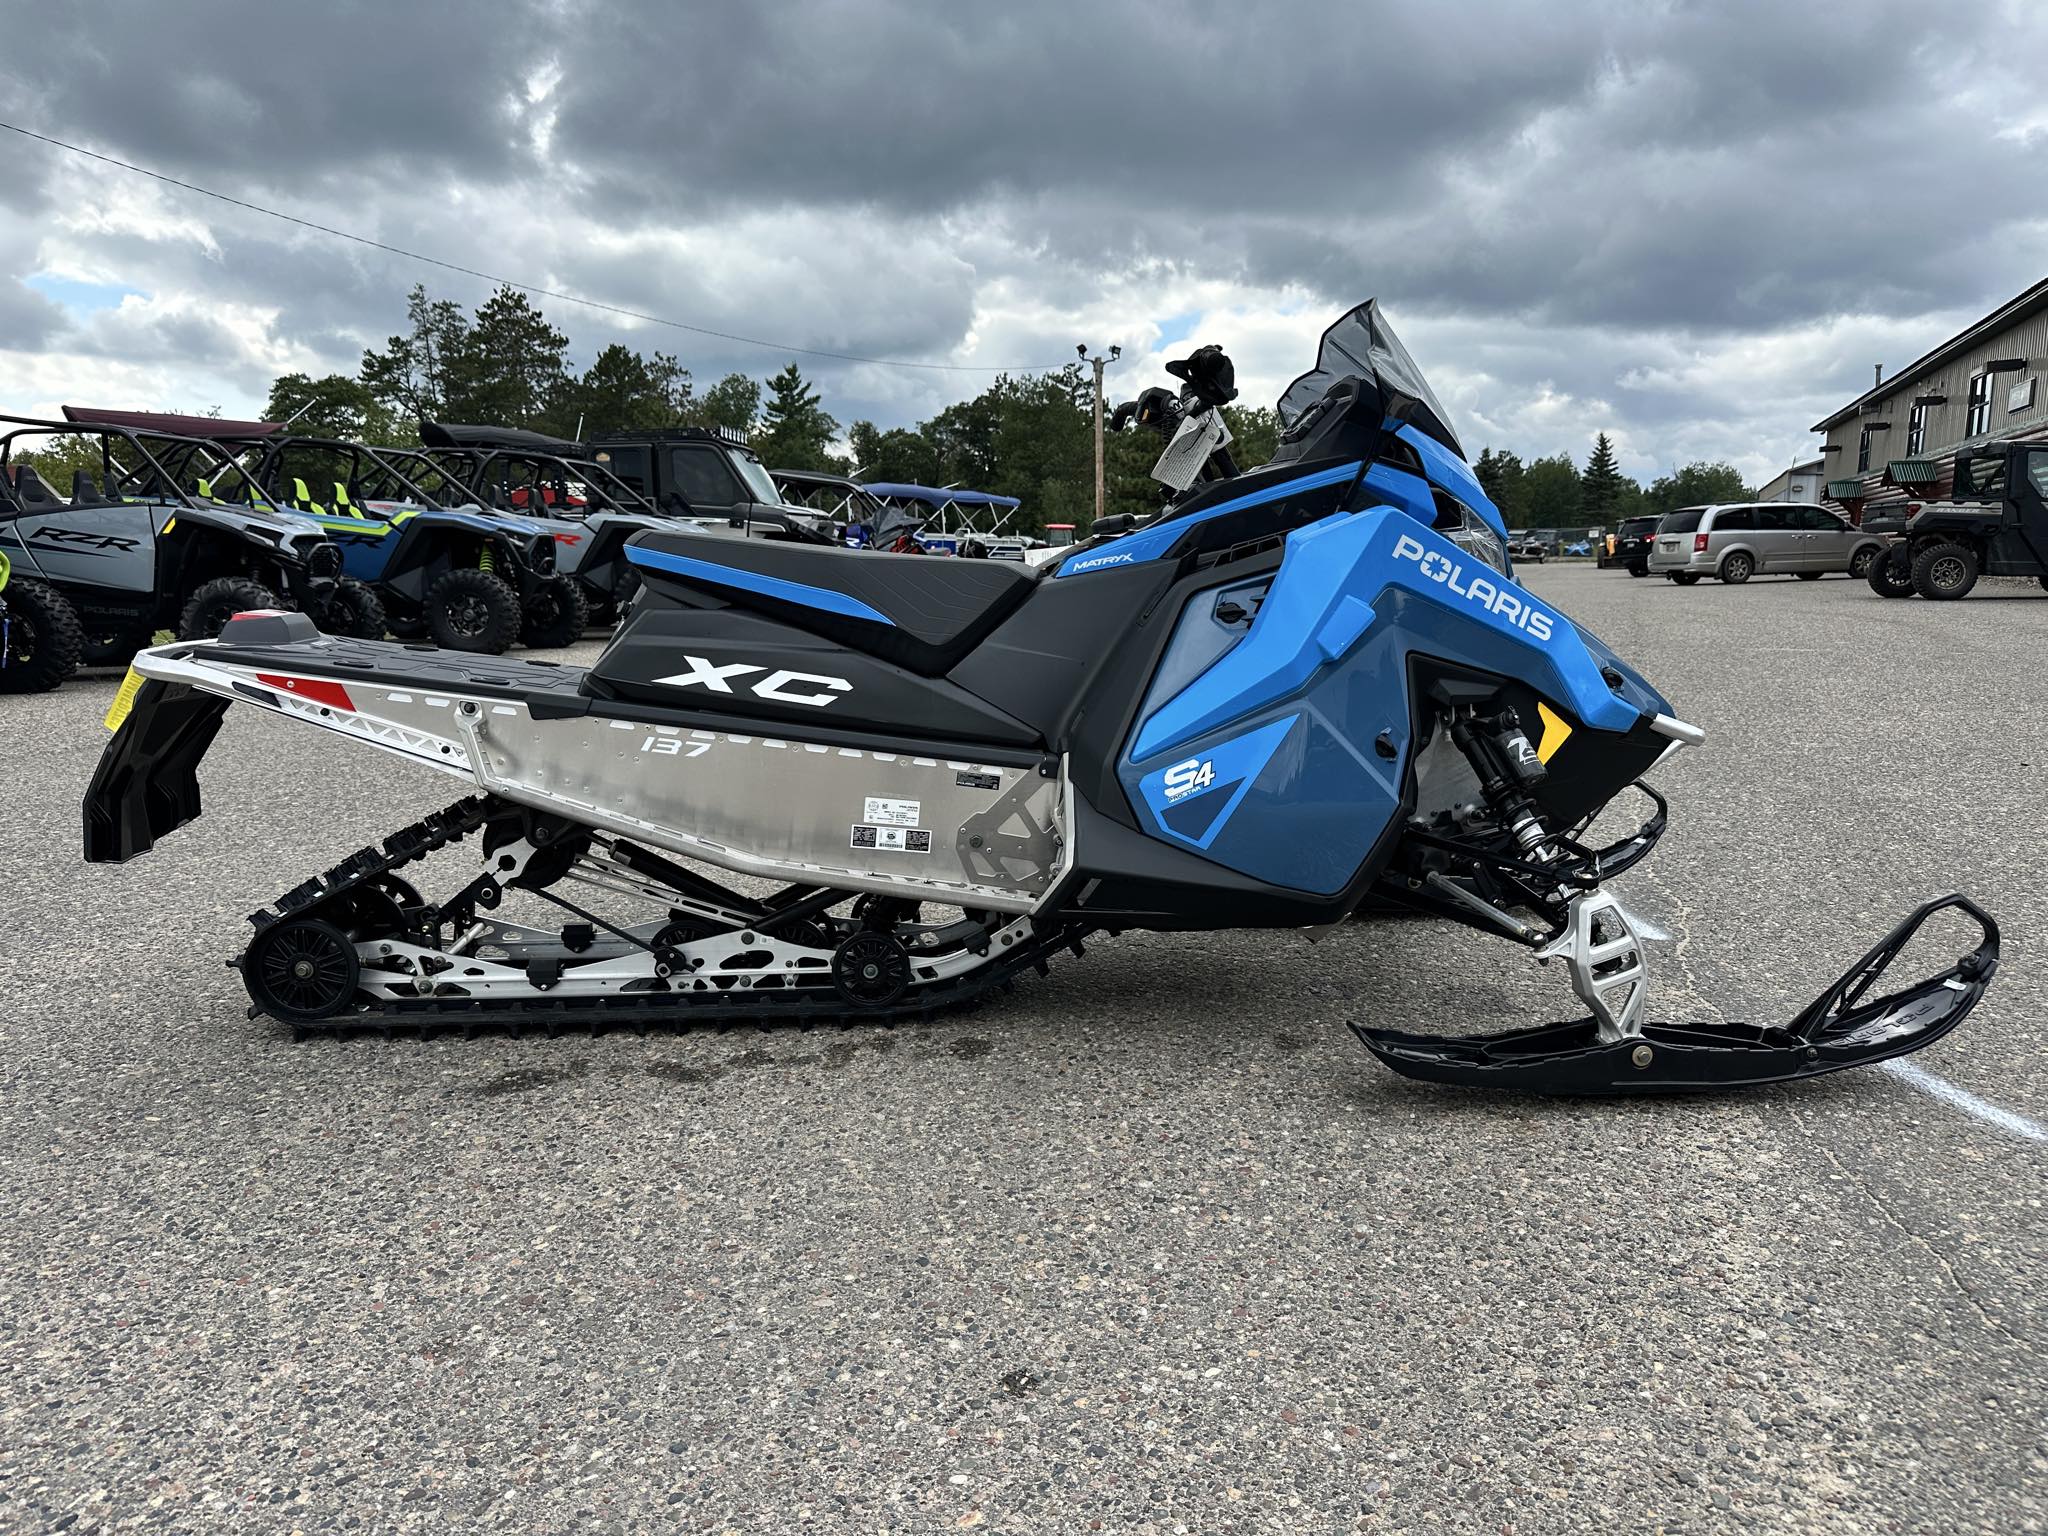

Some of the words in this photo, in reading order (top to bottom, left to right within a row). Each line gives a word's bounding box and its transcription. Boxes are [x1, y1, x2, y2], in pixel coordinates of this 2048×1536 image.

[29, 526, 141, 553] RZR
[1073, 553, 1134, 572] MATRYX
[1391, 534, 1554, 641] POLARIS
[83, 606, 139, 617] POLARIS
[651, 655, 854, 707] XC
[640, 736, 712, 757] 137
[1164, 759, 1216, 797] S4
